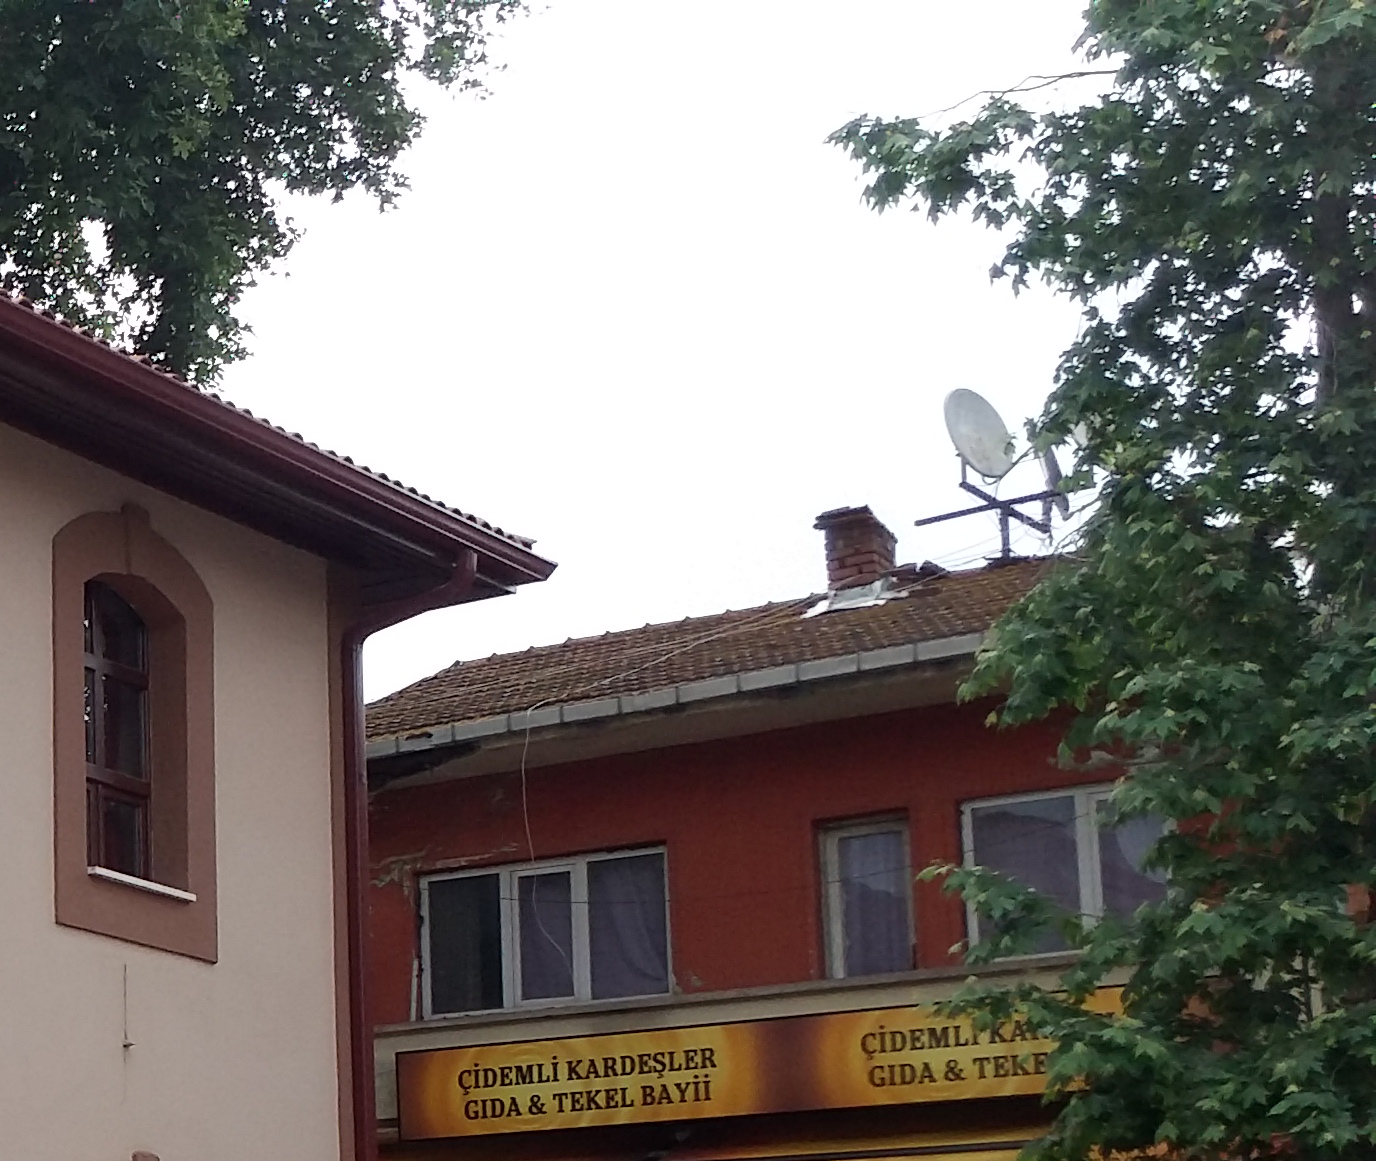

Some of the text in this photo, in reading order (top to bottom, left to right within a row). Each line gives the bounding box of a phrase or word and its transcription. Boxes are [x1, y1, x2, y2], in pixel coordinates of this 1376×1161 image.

[458, 1047, 717, 1095] ÇİDEMLİ KARDEŞLER
[868, 1051, 1048, 1088] GIDA & TEKE
[464, 1074, 712, 1120] GIDA & TEKEL BAYİİ
